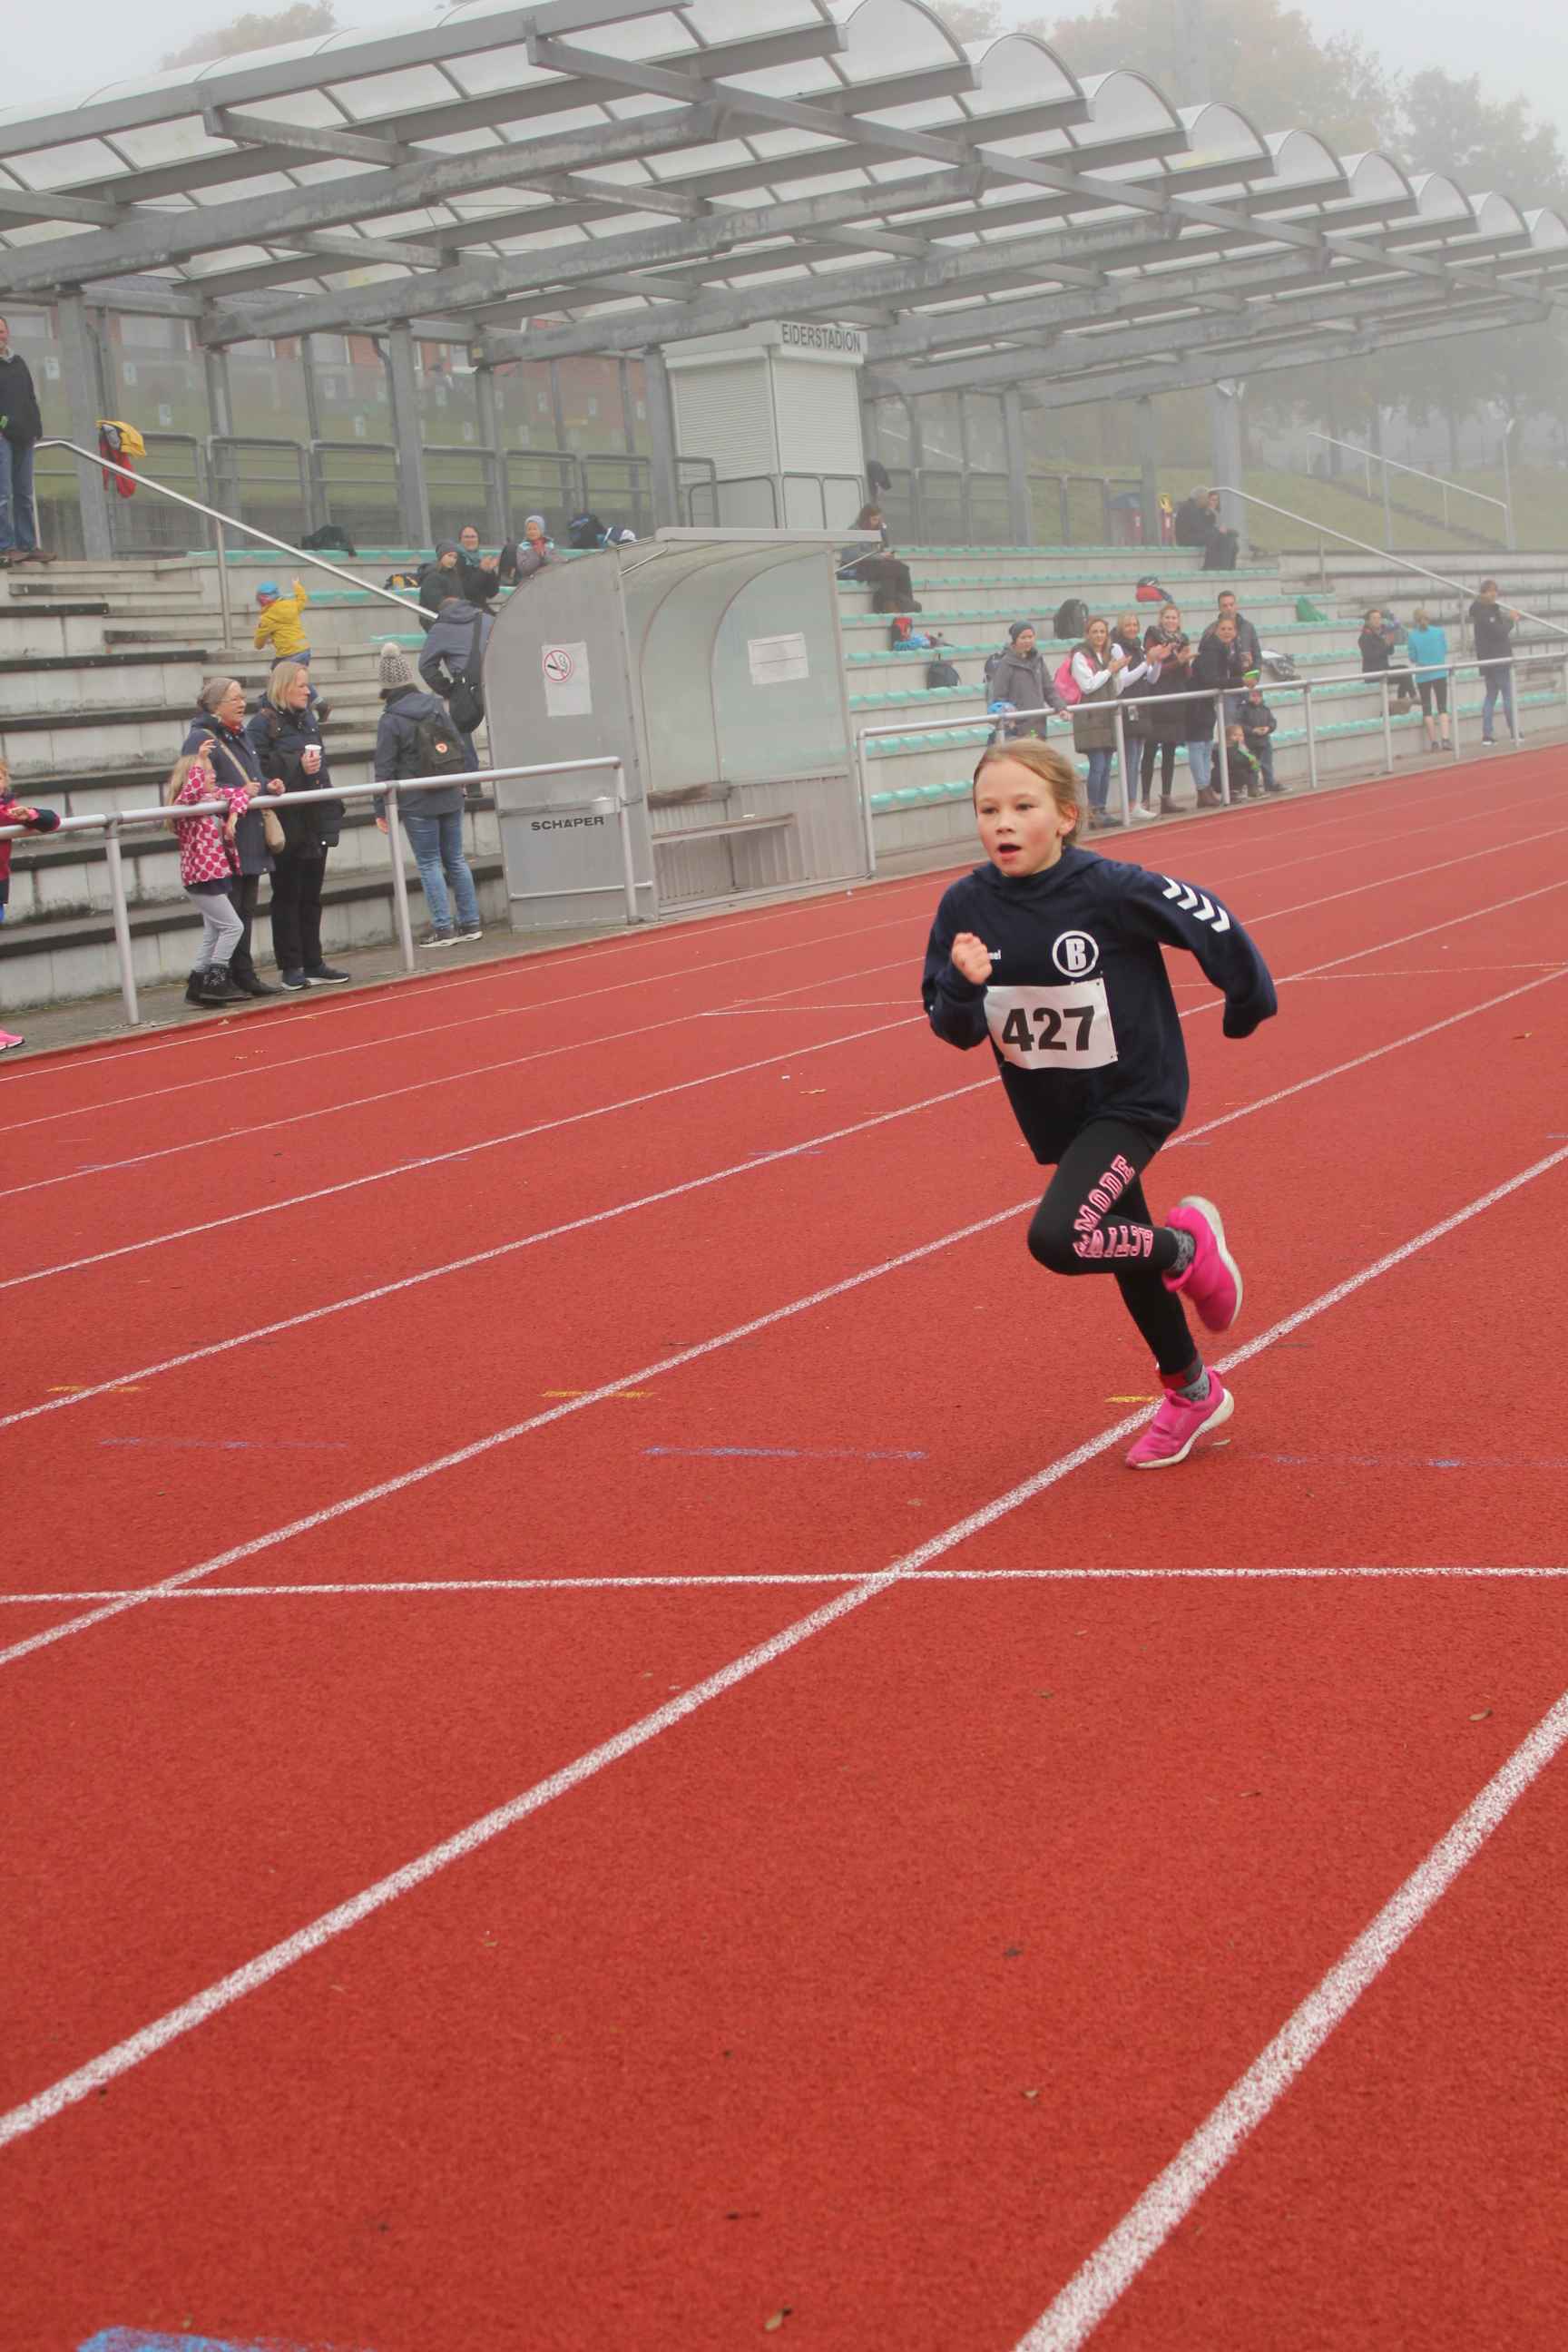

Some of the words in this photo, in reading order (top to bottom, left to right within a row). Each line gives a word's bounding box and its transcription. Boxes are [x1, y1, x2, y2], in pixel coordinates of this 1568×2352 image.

[782, 323, 860, 352] EIDERSTADION
[1065, 937, 1087, 971] B
[1002, 1004, 1094, 1053] 427
[1073, 1154, 1135, 1232] MODE
